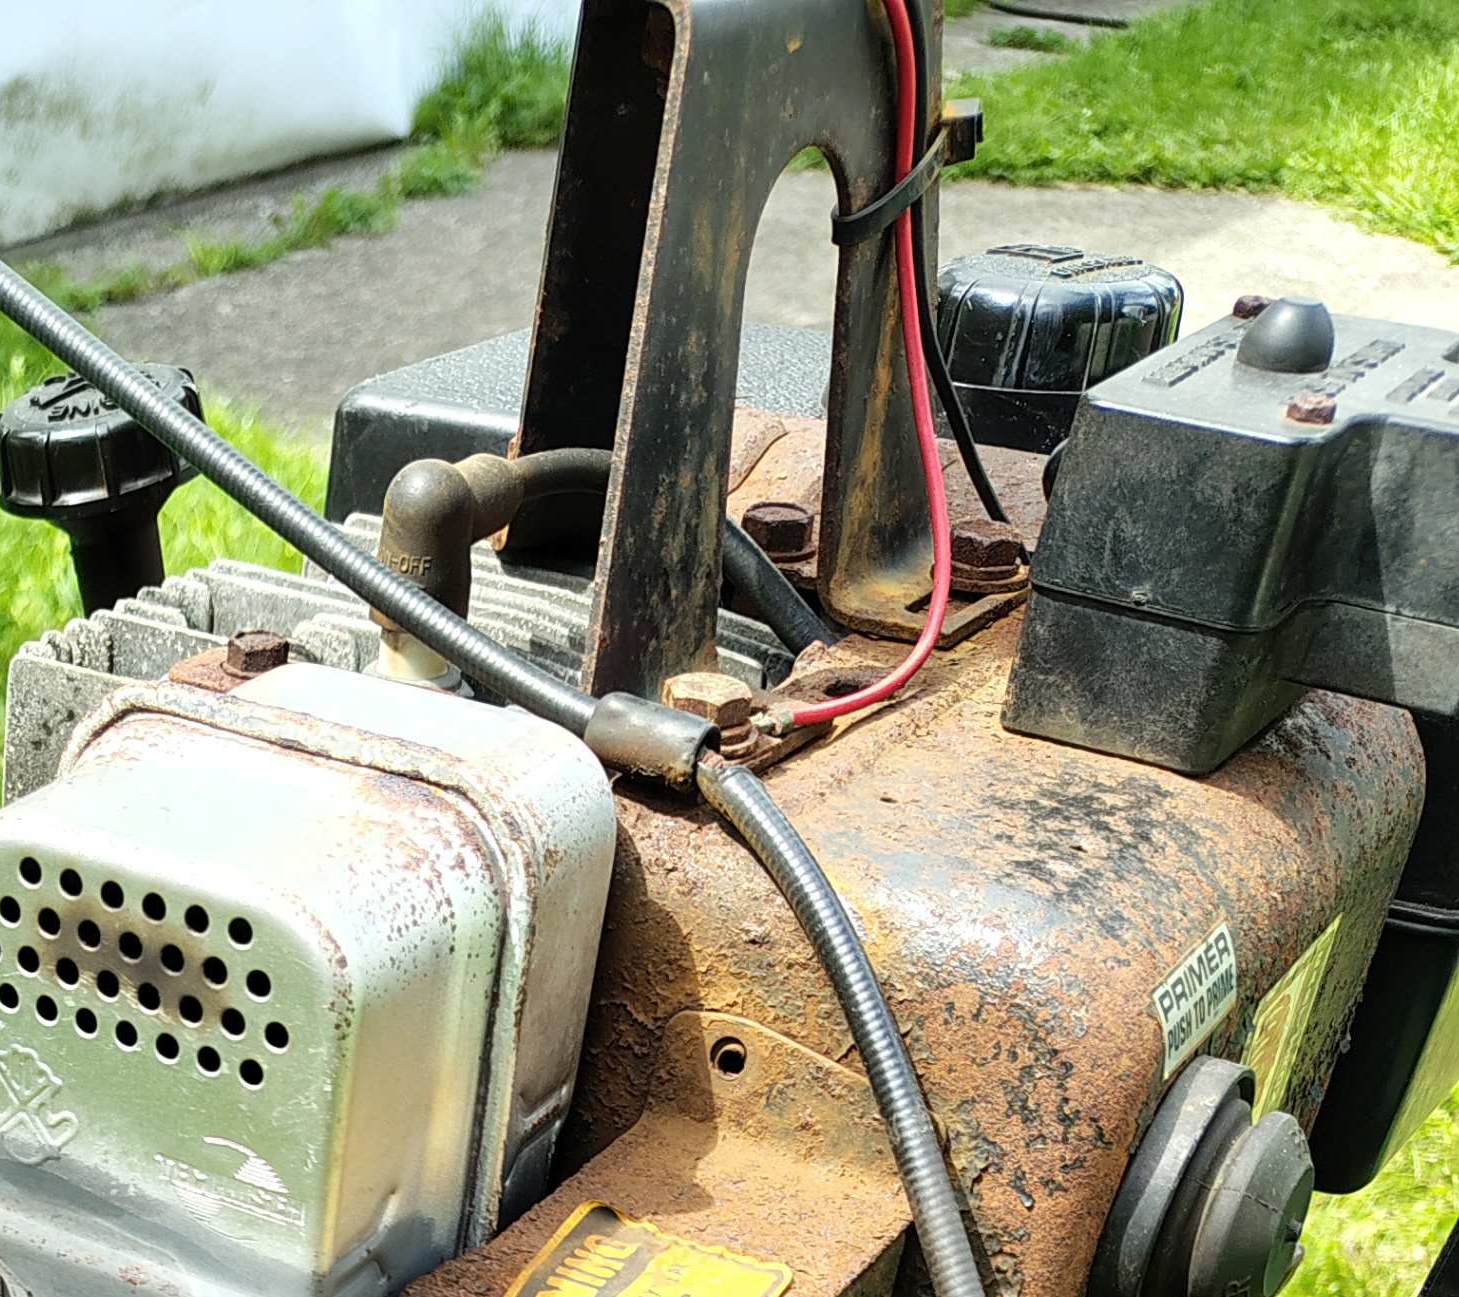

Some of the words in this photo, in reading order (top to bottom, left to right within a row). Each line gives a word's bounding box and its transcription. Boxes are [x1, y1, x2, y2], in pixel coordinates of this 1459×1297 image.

[1158, 931, 1231, 1024] PRIMER
[1167, 1008, 1193, 1060] PUSH
[1193, 994, 1206, 1030] TO
[1206, 962, 1234, 1018] PRIME
